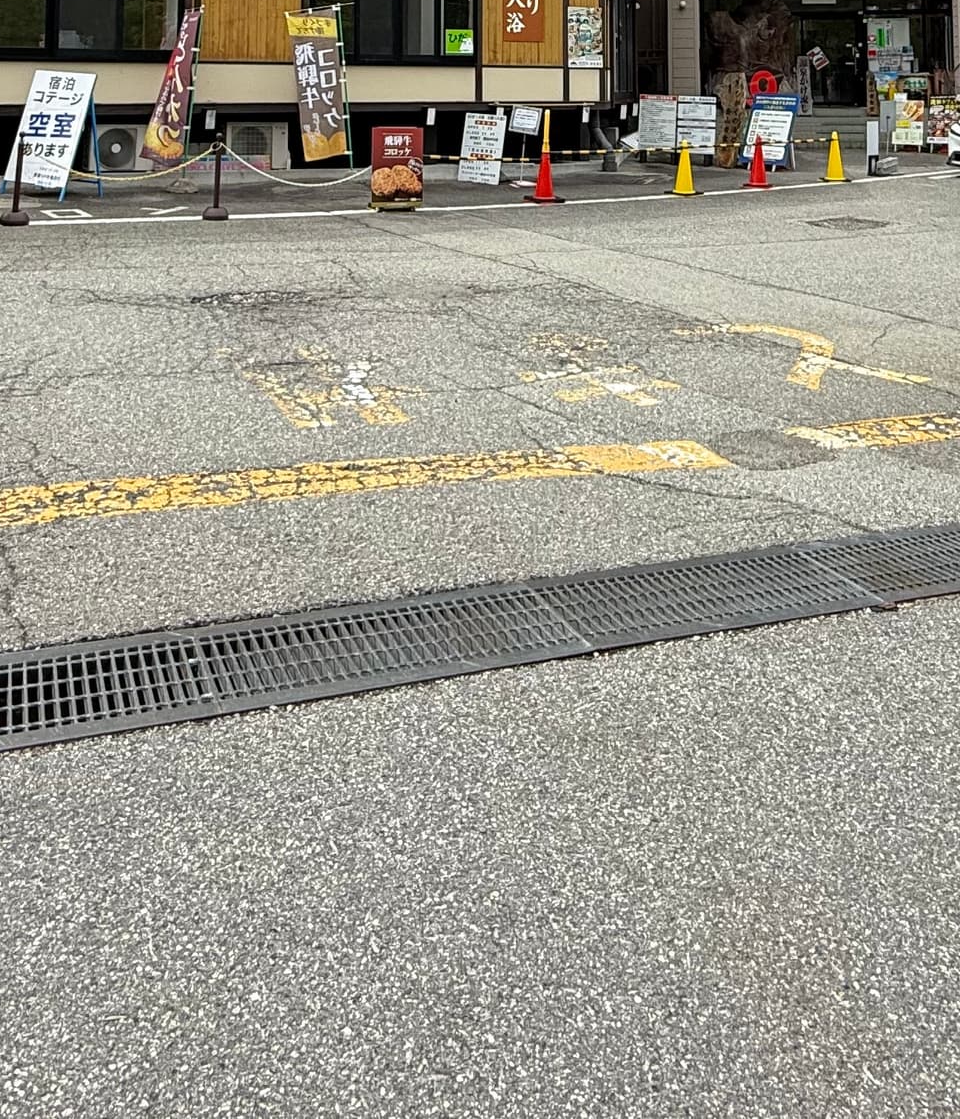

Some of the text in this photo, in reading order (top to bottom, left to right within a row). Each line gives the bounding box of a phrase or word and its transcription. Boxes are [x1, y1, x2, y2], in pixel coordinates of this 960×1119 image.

[48, 76, 77, 91] 宿泊
[33, 90, 85, 106] コテージ
[24, 111, 76, 138] 空室
[22, 142, 70, 158] あります
[384, 148, 412, 156] コロッケ
